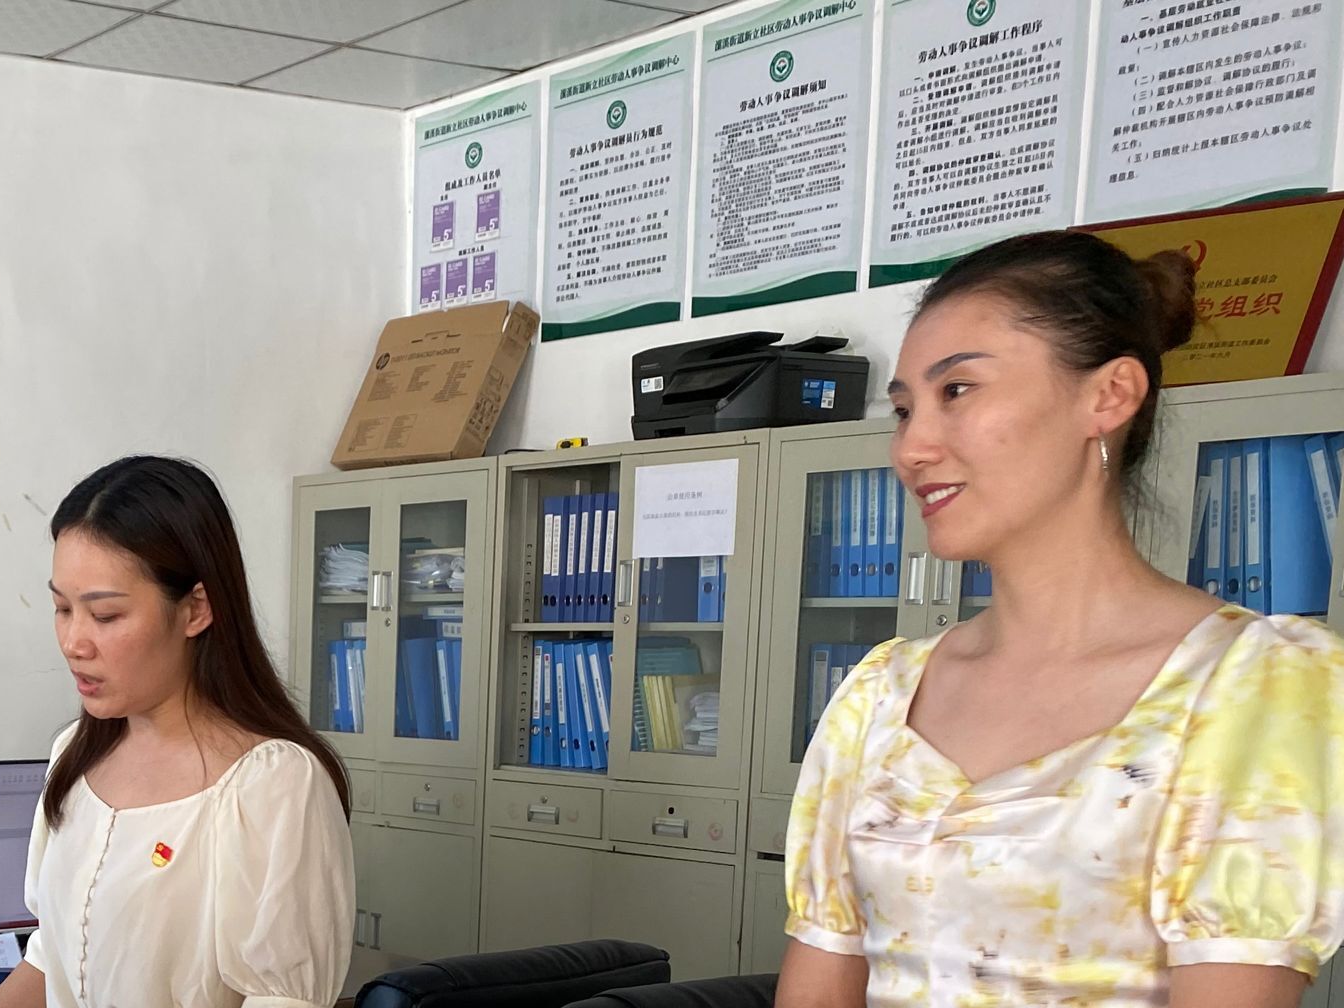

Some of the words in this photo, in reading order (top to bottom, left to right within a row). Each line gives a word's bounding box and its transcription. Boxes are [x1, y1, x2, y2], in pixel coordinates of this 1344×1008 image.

[918, 19, 1044, 64] 劳动人事争议调解工作程序
[740, 79, 827, 112] 劳动人事争议调解须知
